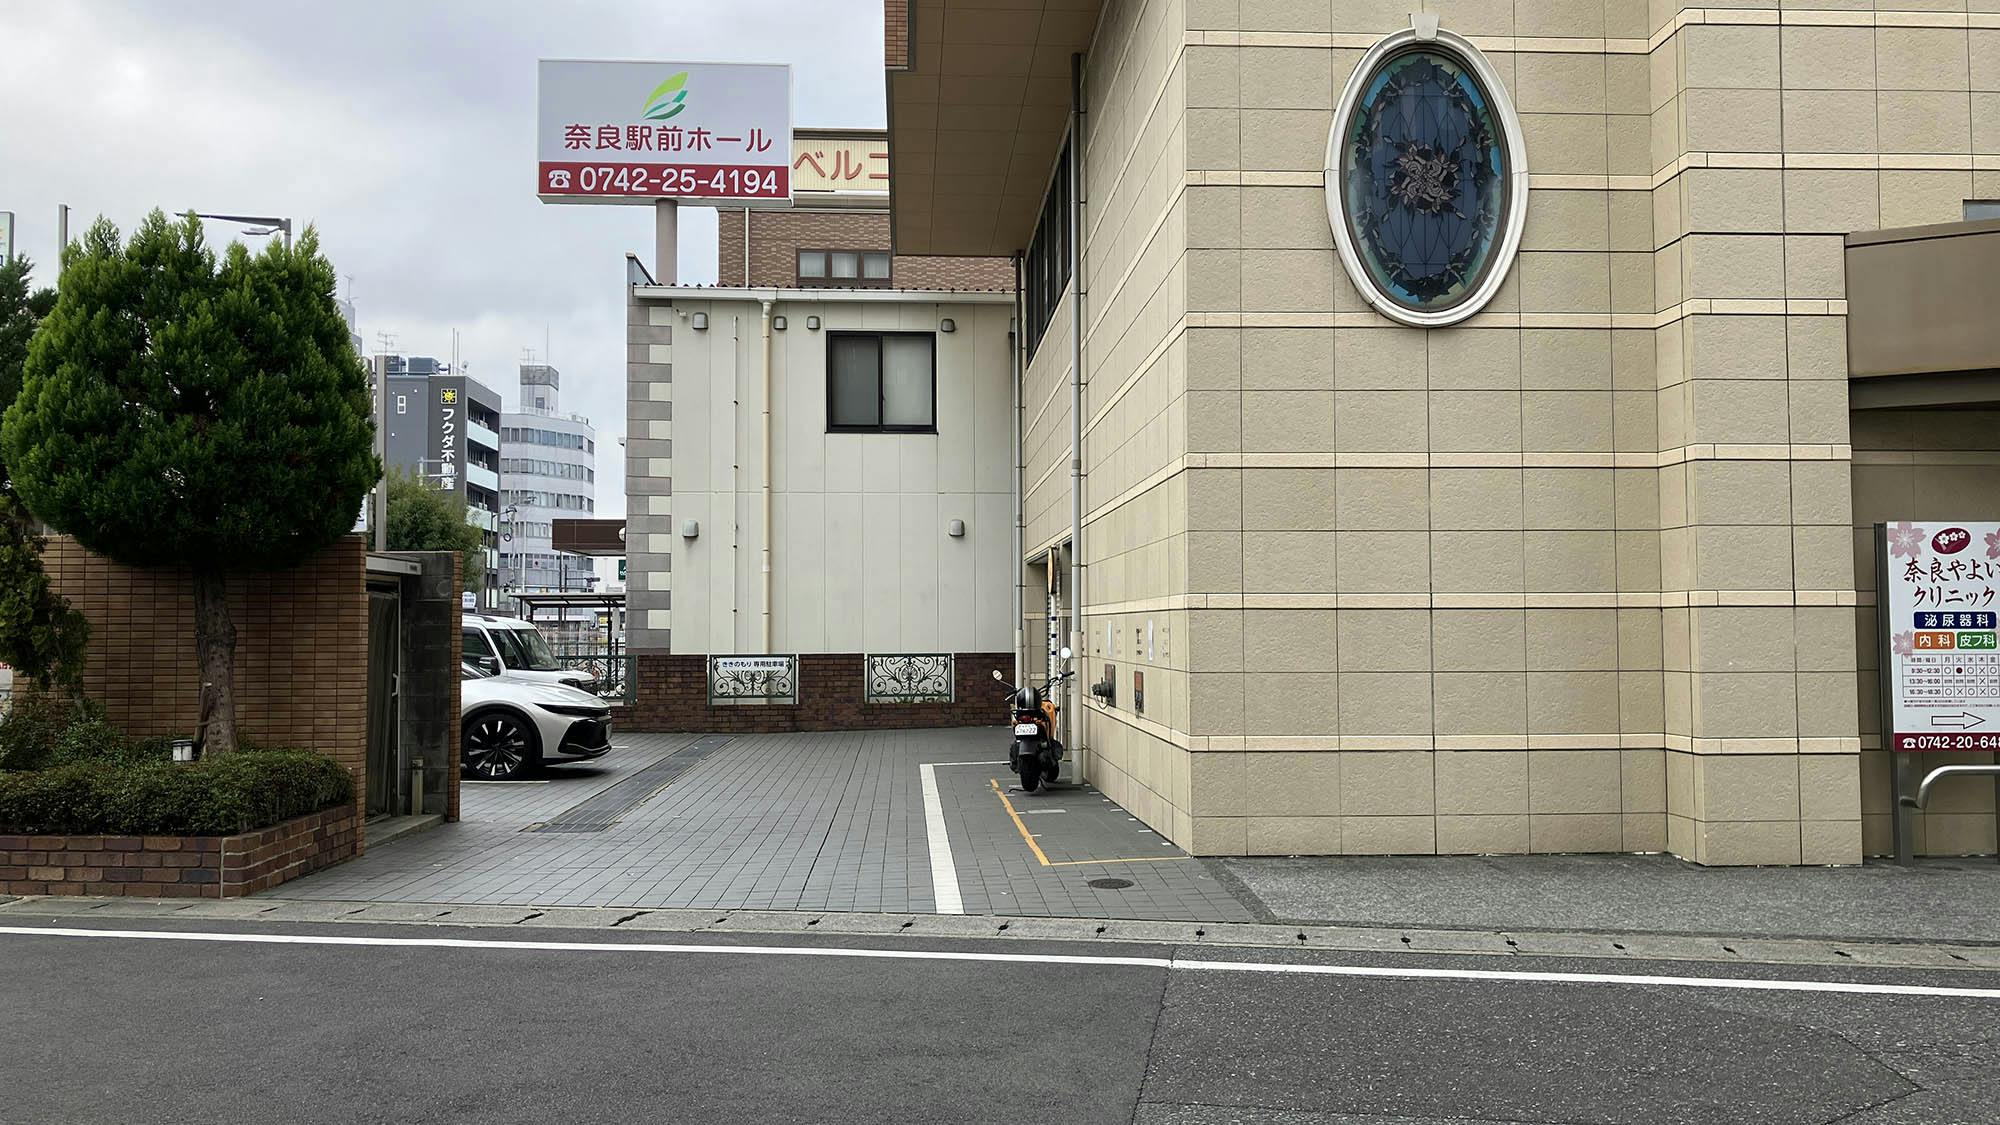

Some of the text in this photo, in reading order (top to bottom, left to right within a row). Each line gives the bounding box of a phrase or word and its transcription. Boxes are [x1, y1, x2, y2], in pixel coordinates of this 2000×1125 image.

[564, 124, 772, 152] 奈良駅前ホール
[579, 166, 778, 194] 0742-25-4194
[441, 408, 455, 490] フクダ不動産
[1904, 557, 2000, 583] 奈良やよい
[1913, 585, 1996, 607] クリニック
[1924, 614, 1989, 627] 泌尿器科
[1919, 634, 1995, 647] 内科 皮フ科
